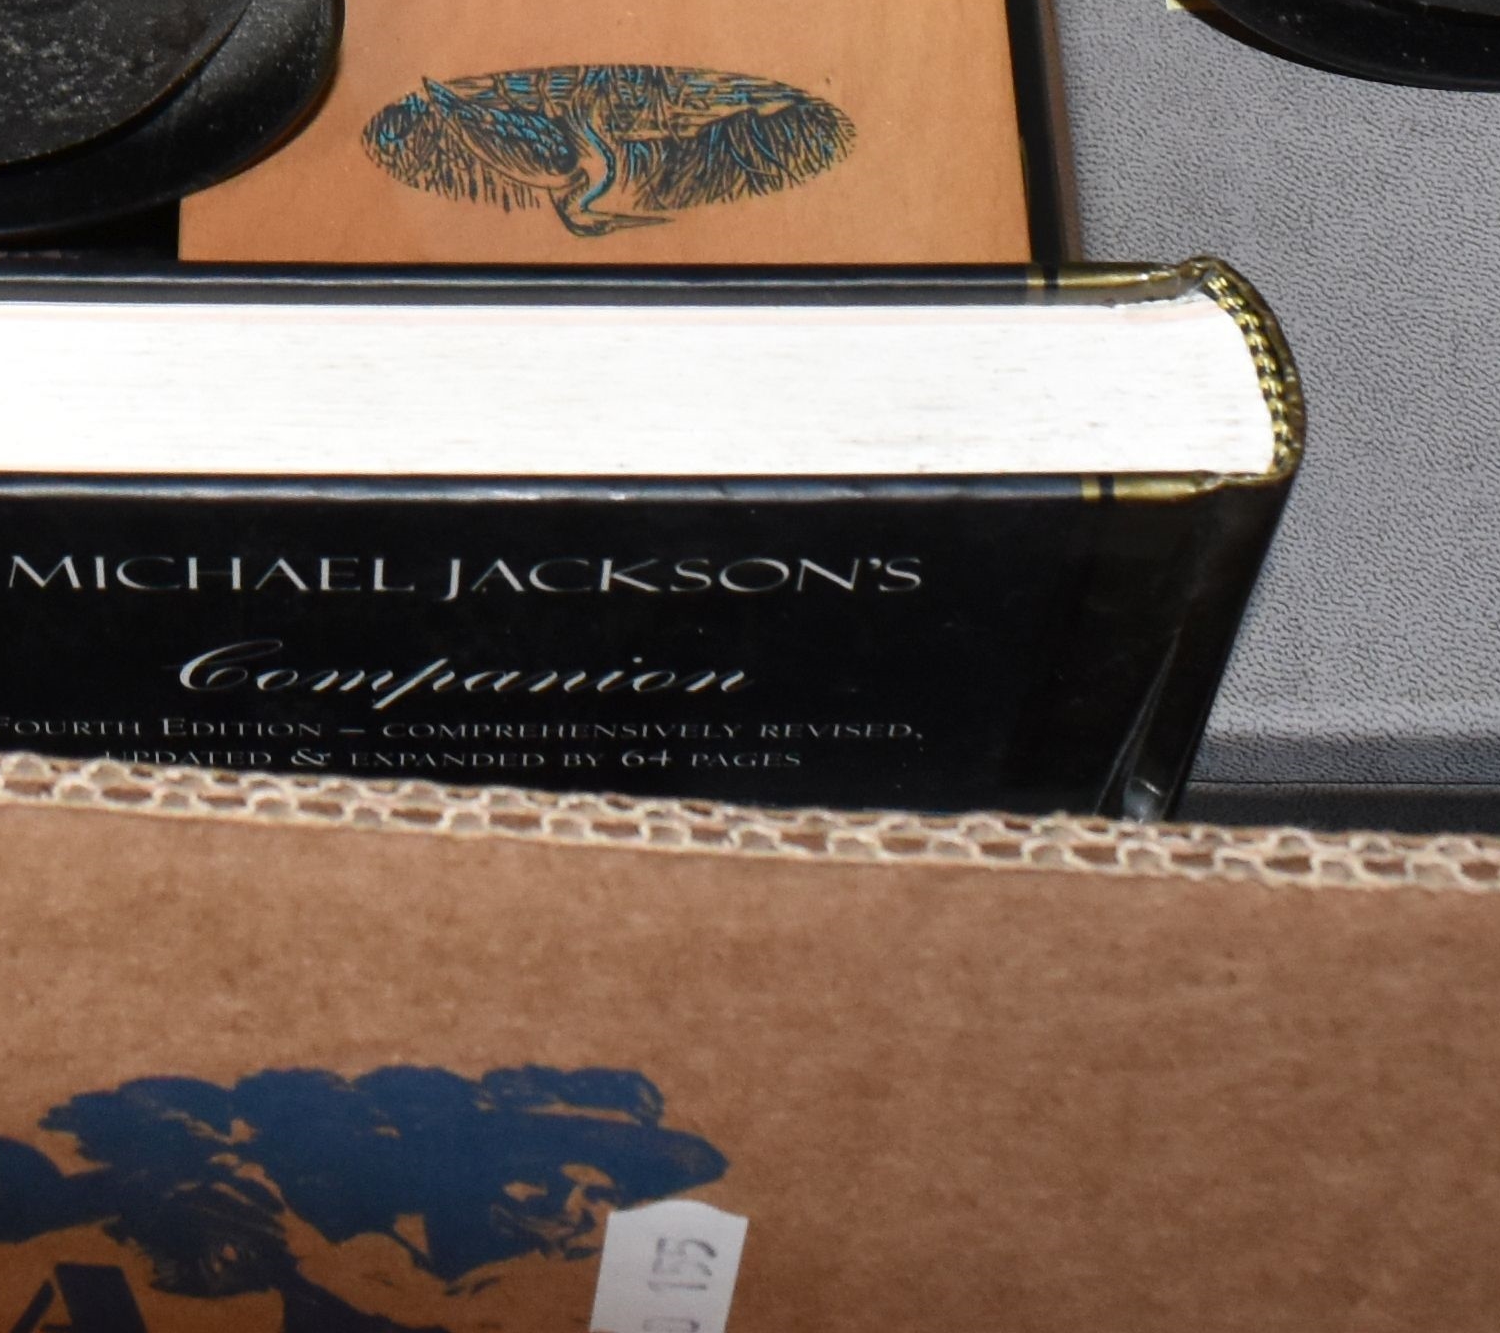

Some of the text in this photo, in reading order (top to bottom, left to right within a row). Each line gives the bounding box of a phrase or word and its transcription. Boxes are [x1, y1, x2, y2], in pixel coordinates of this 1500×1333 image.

[6, 553, 925, 601] MICHAEL JACKSON'S
[175, 637, 756, 711] Companion
[161, 717, 322, 738] EDITION
[382, 721, 743, 740] COMPREHENSIVELY
[289, 747, 333, 768] &
[349, 750, 546, 769] EXPANDED
[561, 751, 604, 769] BY
[620, 748, 674, 769] 64
[689, 751, 802, 769] PAGES
